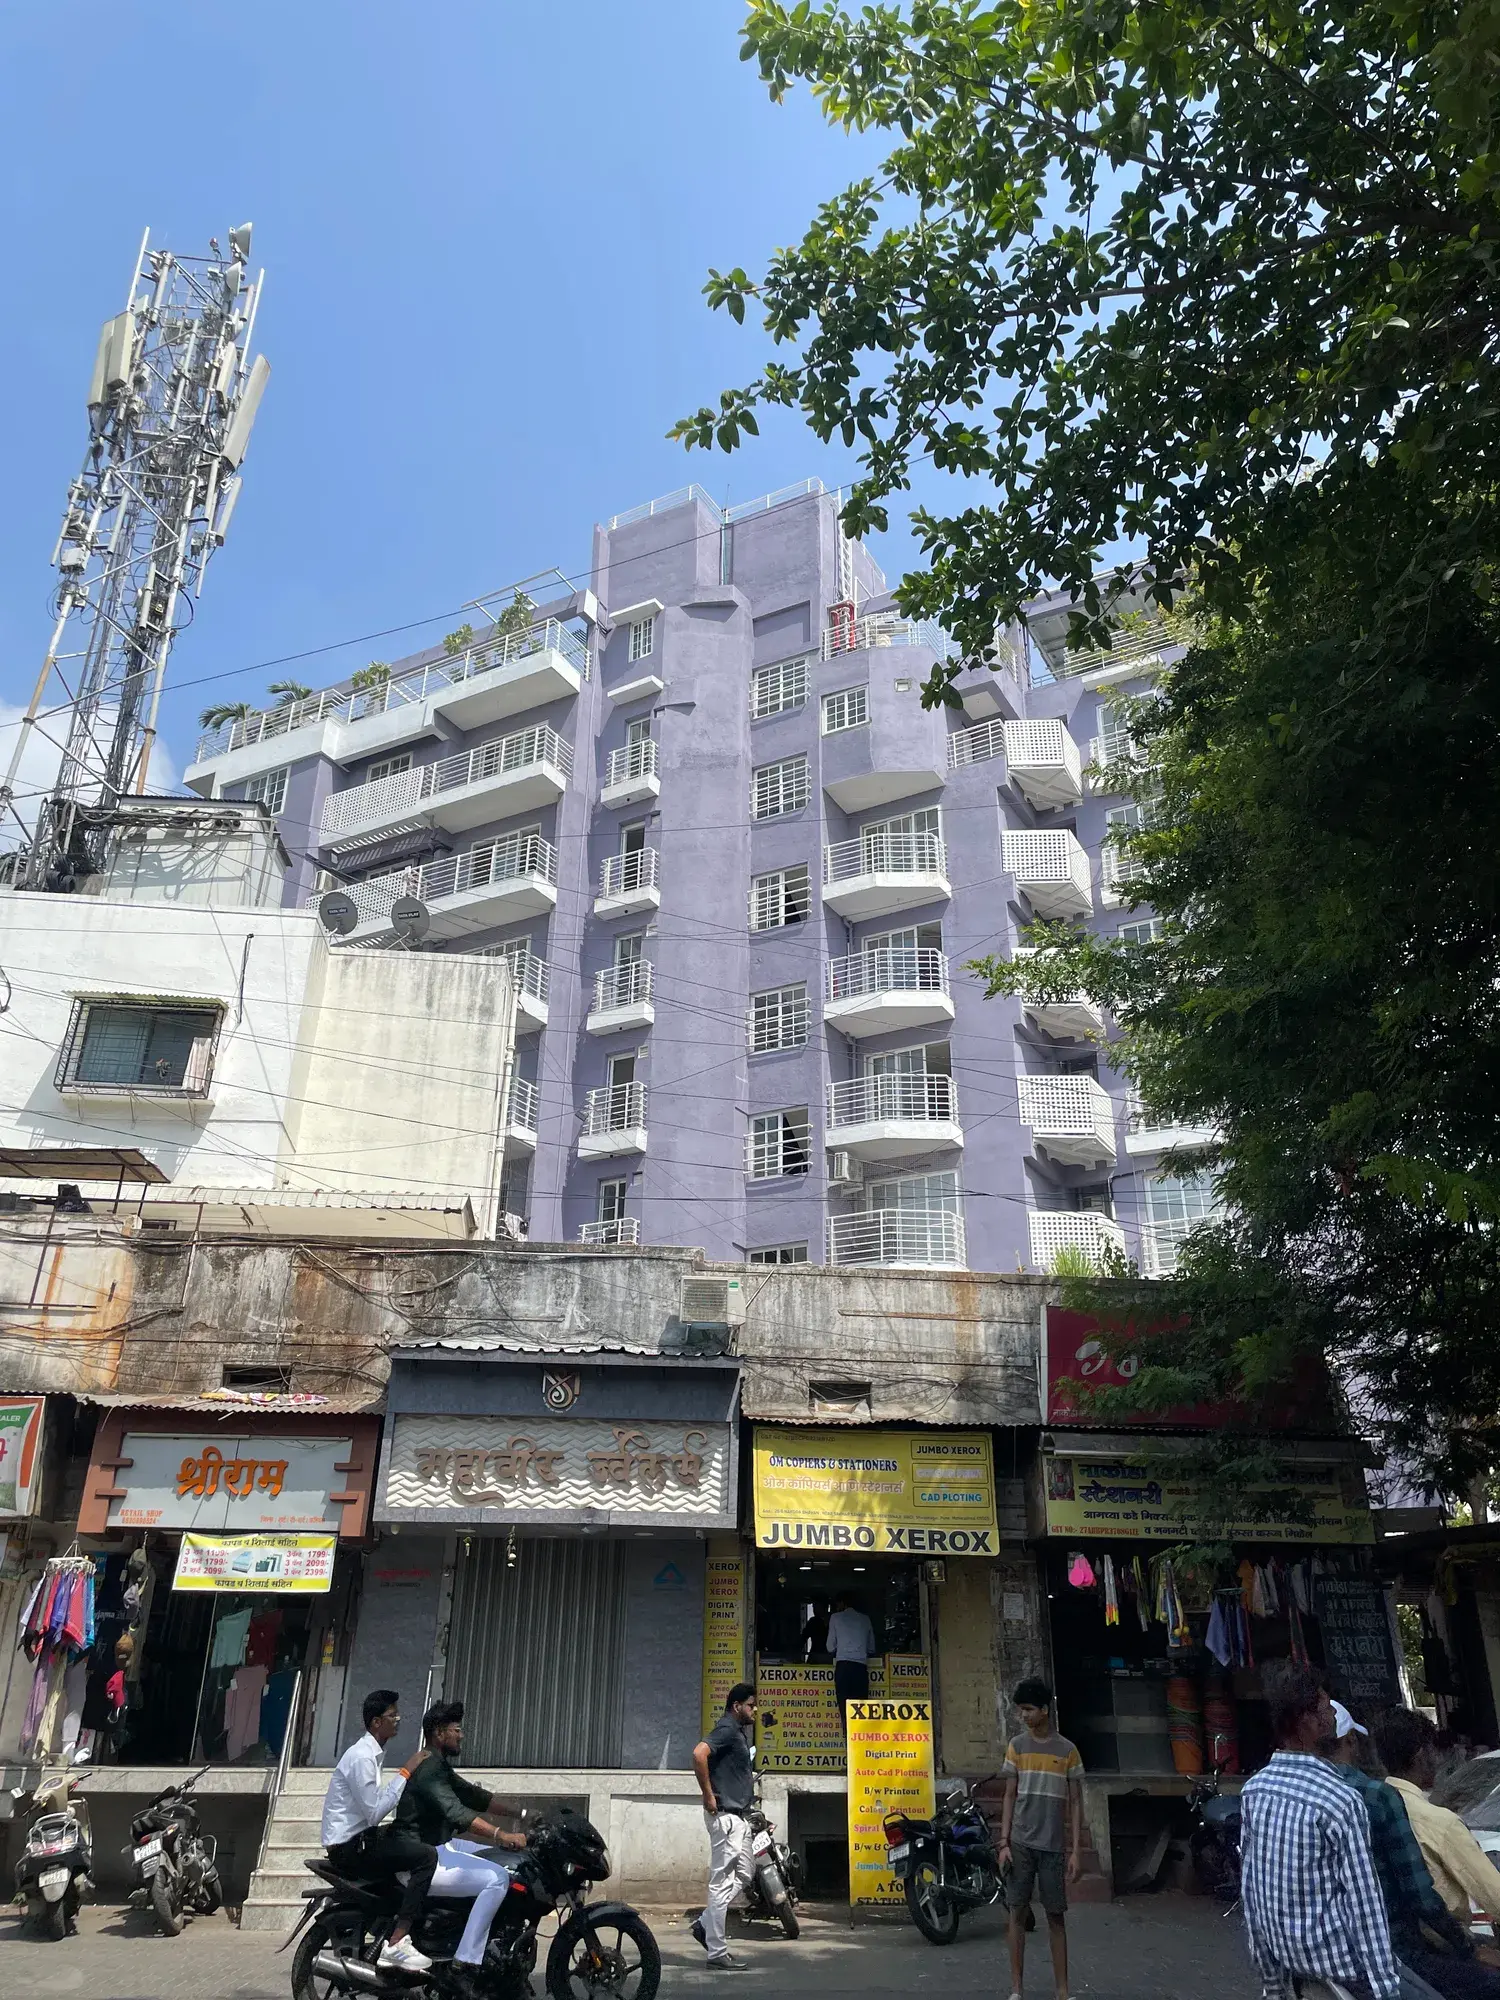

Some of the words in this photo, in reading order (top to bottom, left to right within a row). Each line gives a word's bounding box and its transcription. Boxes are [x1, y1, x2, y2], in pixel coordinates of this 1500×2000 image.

[916, 1445, 949, 1455] JUMBO
[951, 1446, 982, 1455] XEROX
[769, 1456, 784, 1467] OM
[786, 1456, 826, 1470] COPIERS
[828, 1458, 835, 1469] &
[839, 1459, 897, 1471] STATIONERS
[176, 1446, 289, 1497] श्रीराम
[763, 1474, 786, 1489] ओम
[833, 1477, 859, 1492] आणि
[920, 1492, 941, 1502] CAD
[943, 1493, 982, 1502] PLOTING
[1078, 1480, 1163, 1505] स्टेशनरी
[762, 1522, 875, 1548] JUMBO
[886, 1527, 992, 1553] XEROX
[185, 1548, 190, 1556] 3
[308, 1550, 330, 1558] 1799/-
[183, 1557, 188, 1565] 3
[205, 1558, 228, 1566] 1799/-
[306, 1559, 329, 1567] 2099/-
[182, 1566, 187, 1574] 3
[203, 1567, 227, 1575] 2099/-
[708, 1562, 741, 1572] XEROX
[305, 1568, 328, 1576] 2399/-
[709, 1577, 739, 1586] JUMBO
[709, 1587, 739, 1596] XEROX
[708, 1601, 738, 1610] DIGITA
[711, 1611, 735, 1620] PRINT
[892, 1664, 929, 1676] XEROX
[760, 1669, 798, 1681] XEROX
[804, 1670, 834, 1682] XERO
[758, 1688, 788, 1696] JUMBO
[791, 1689, 820, 1697] XEROX
[759, 1699, 785, 1707] COLOUR
[786, 1700, 819, 1708] PRINTOUT
[783, 1711, 804, 1719] AUTO
[806, 1711, 822, 1719] CAD
[850, 1703, 930, 1721] XEROX
[782, 1721, 806, 1729] SPIRAL
[851, 1732, 890, 1742] JUMBO
[892, 1733, 930, 1742] XEROX
[865, 1749, 893, 1759] Digital
[895, 1750, 917, 1759] Print
[762, 1755, 770, 1766] A
[774, 1755, 790, 1766] TO
[794, 1755, 803, 1766] Z
[855, 1768, 875, 1776] Auto
[877, 1768, 893, 1776] Cad
[895, 1768, 929, 1778] Plotting
[864, 1786, 882, 1796] B/w
[884, 1787, 920, 1795] Printout
[859, 1805, 887, 1814] Colour
[889, 1805, 926, 1814] Printout
[854, 1824, 880, 1833] Spiral
[854, 1843, 872, 1852] B/w
[855, 1862, 884, 1870] Jumbo
[876, 1882, 885, 1893] A
[887, 1882, 904, 1893] TO
